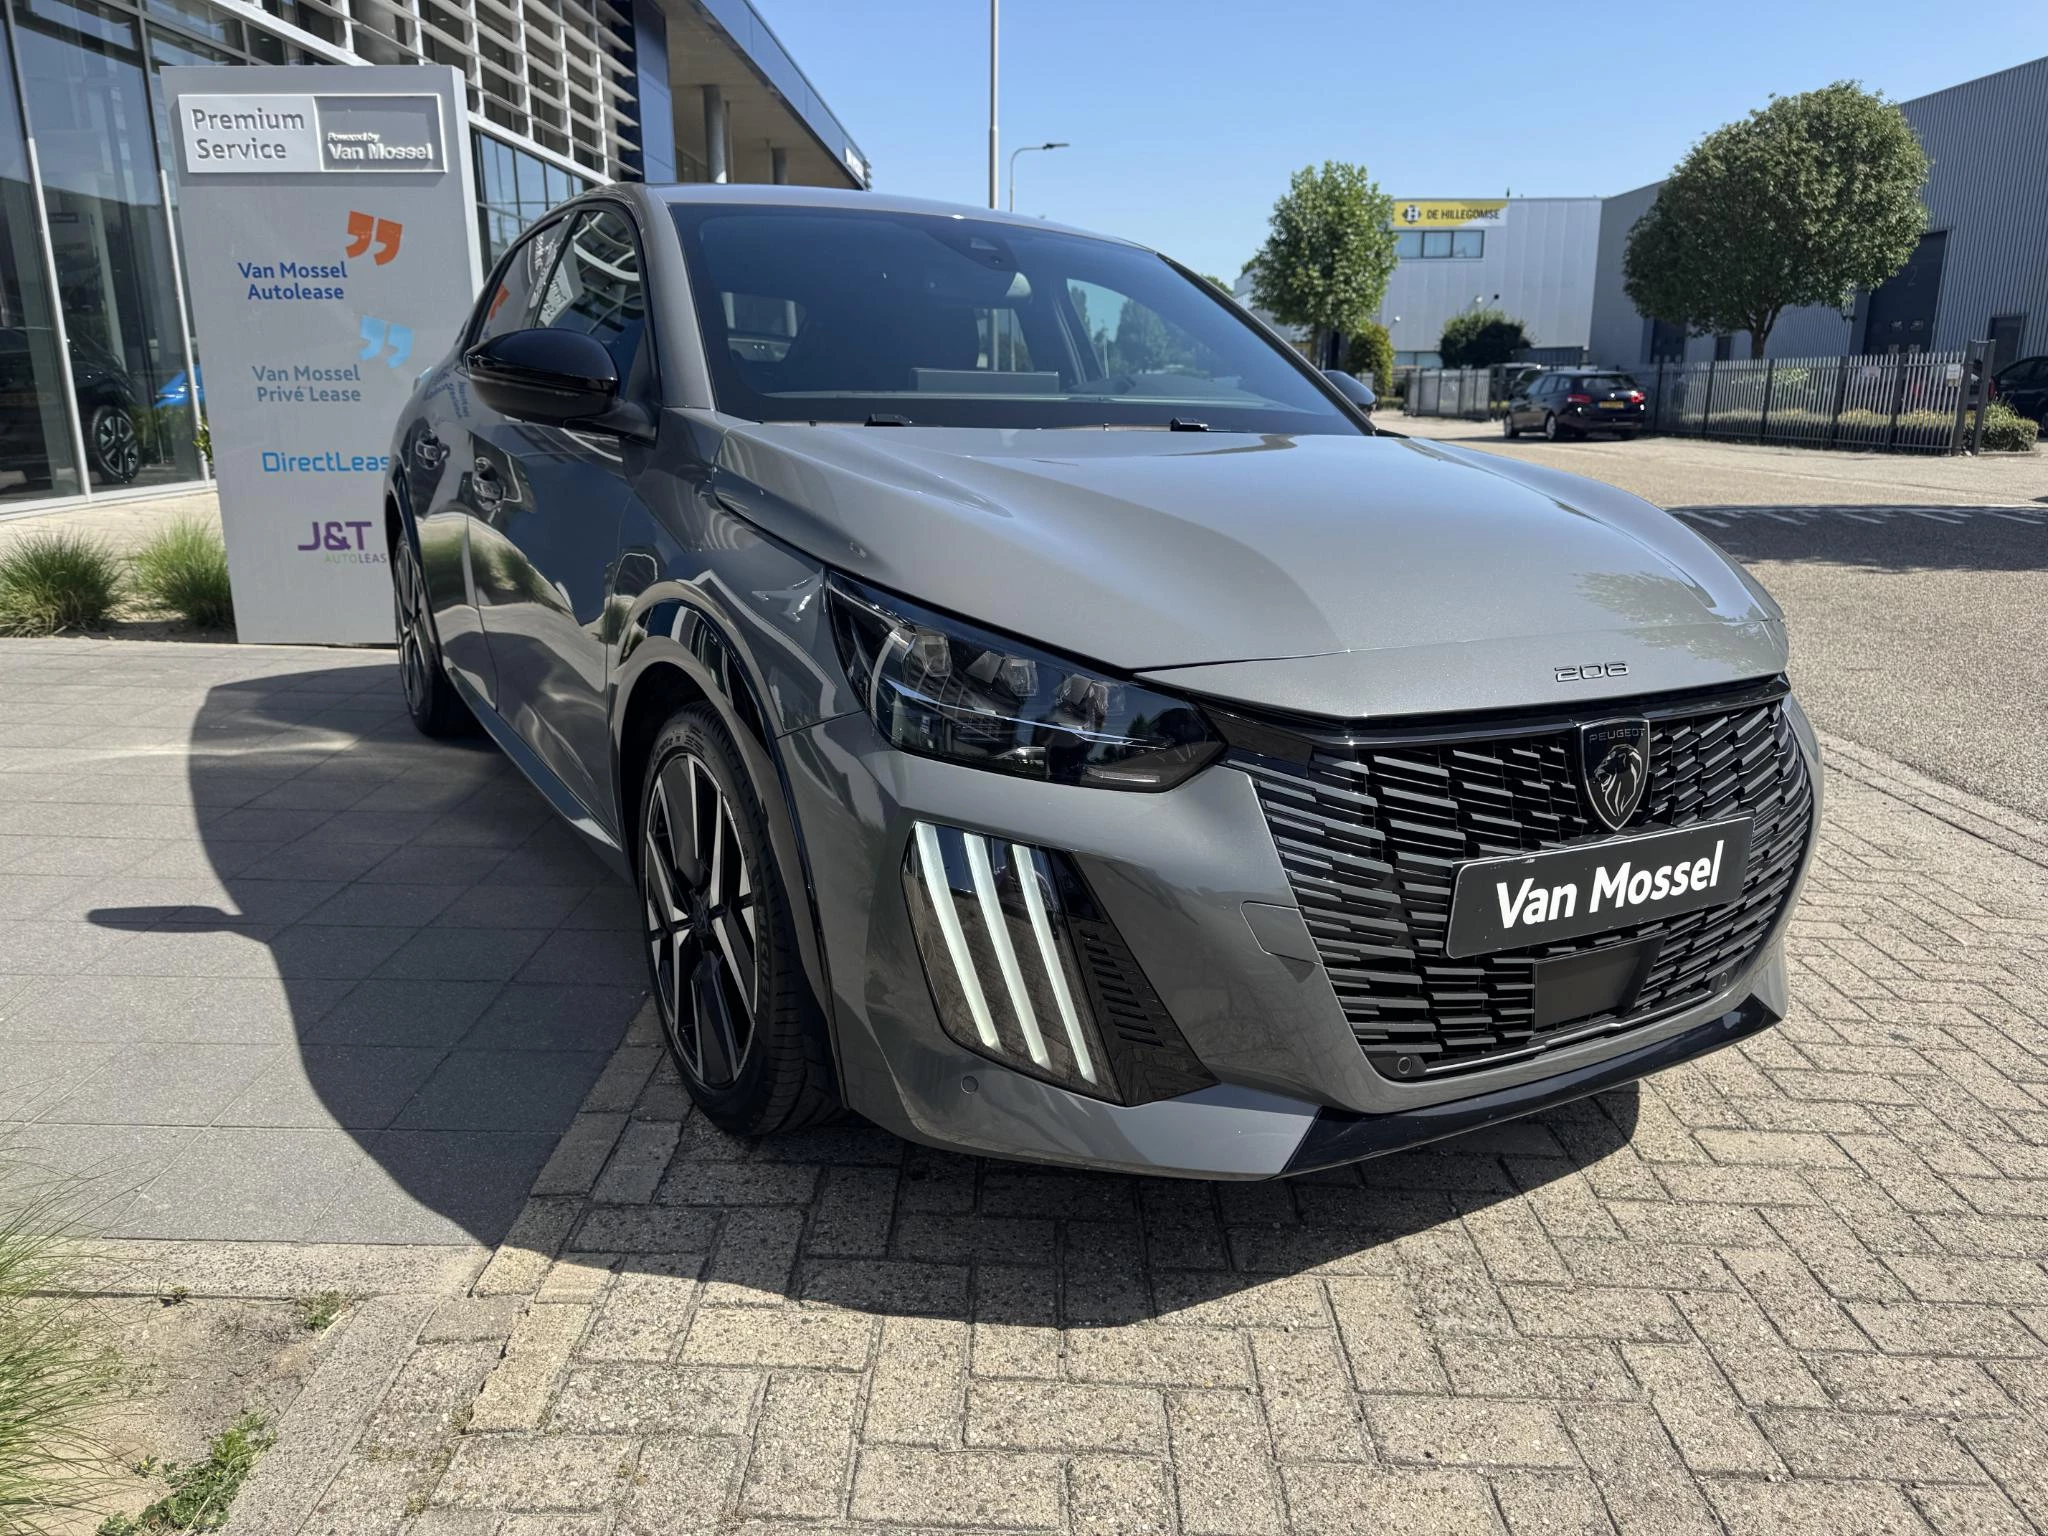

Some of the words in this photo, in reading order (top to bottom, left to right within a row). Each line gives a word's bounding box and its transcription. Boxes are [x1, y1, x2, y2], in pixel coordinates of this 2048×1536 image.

[191, 107, 306, 131] Premium
[327, 132, 367, 142] Powered
[368, 132, 380, 143] by
[196, 137, 288, 160] Service
[327, 142, 365, 160] Van
[367, 142, 434, 160] Mossel
[1426, 208, 1438, 220] DE
[1440, 208, 1500, 220] HILLEGOMSE
[238, 262, 275, 279] Van
[280, 260, 348, 279] Mossel
[247, 283, 345, 300] Autolease
[252, 366, 289, 382] Van
[293, 364, 361, 382] Mossel
[257, 385, 304, 402] Privé
[309, 386, 361, 402] Lease
[262, 451, 390, 473] DirectLeas
[297, 520, 373, 551] J&T
[324, 552, 388, 565] AUTOLEAS
[1554, 661, 1630, 683] 208
[1589, 727, 1646, 744] PEUGEOT
[1496, 877, 1578, 929] Van
[1588, 839, 1725, 914] Mossel
